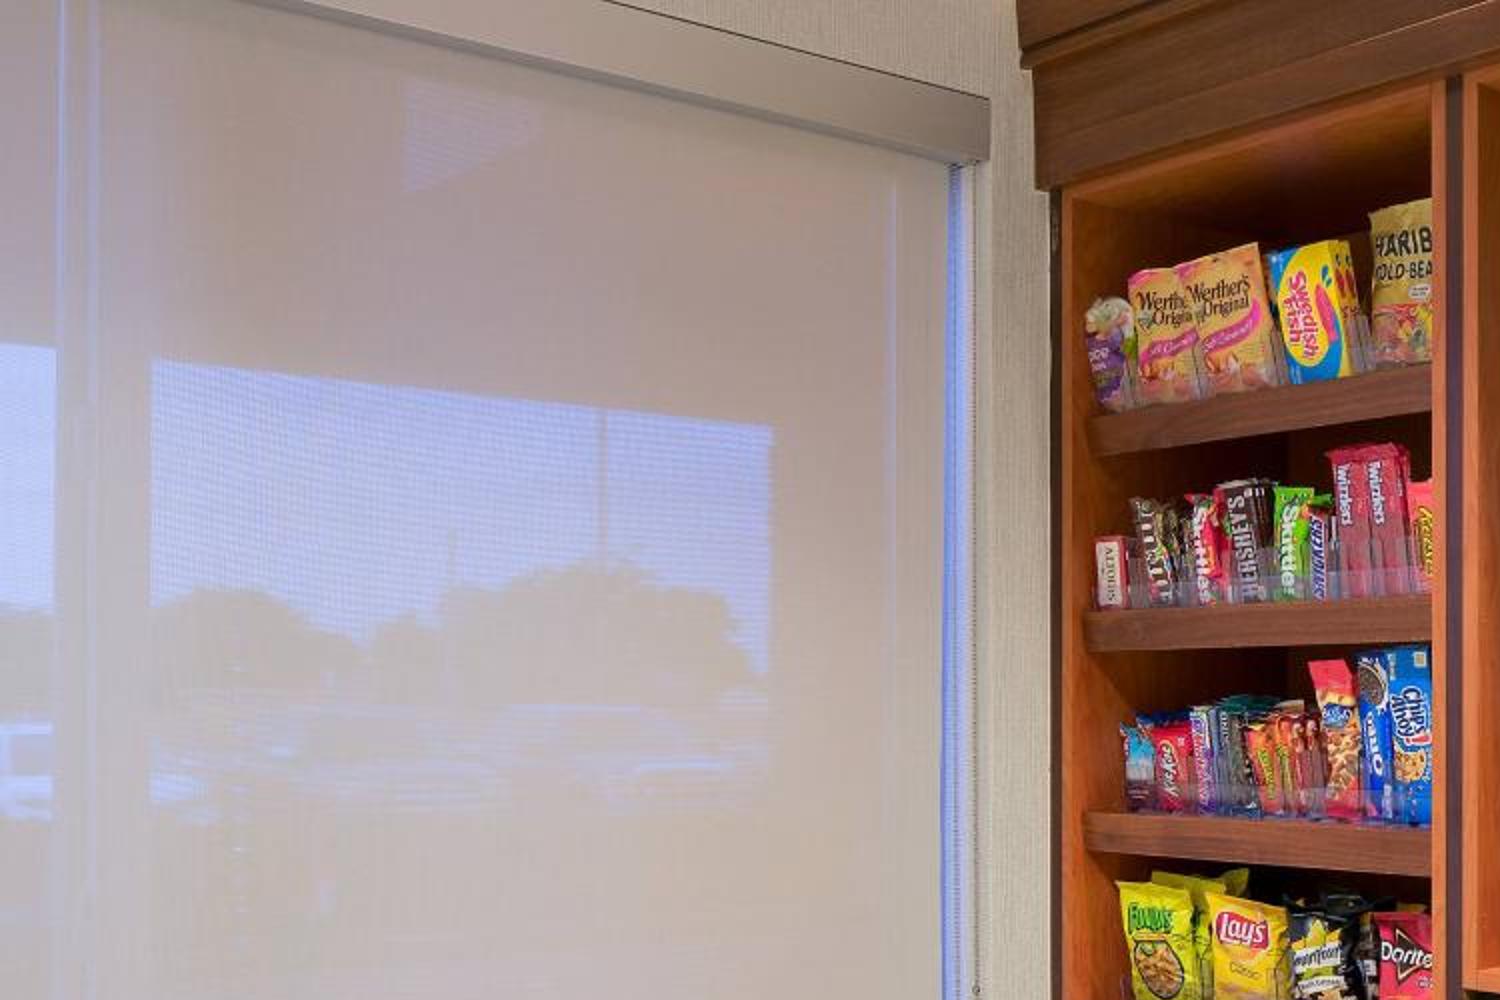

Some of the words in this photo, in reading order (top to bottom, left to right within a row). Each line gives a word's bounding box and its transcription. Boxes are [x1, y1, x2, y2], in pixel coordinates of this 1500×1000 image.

[1376, 227, 1432, 258] HARIB
[1283, 297, 1302, 344] Fish
[1288, 270, 1319, 358] Swedish
[1402, 687, 1427, 736] Chips
[1219, 912, 1267, 945] Lay's
[1381, 941, 1432, 968] Dorito
